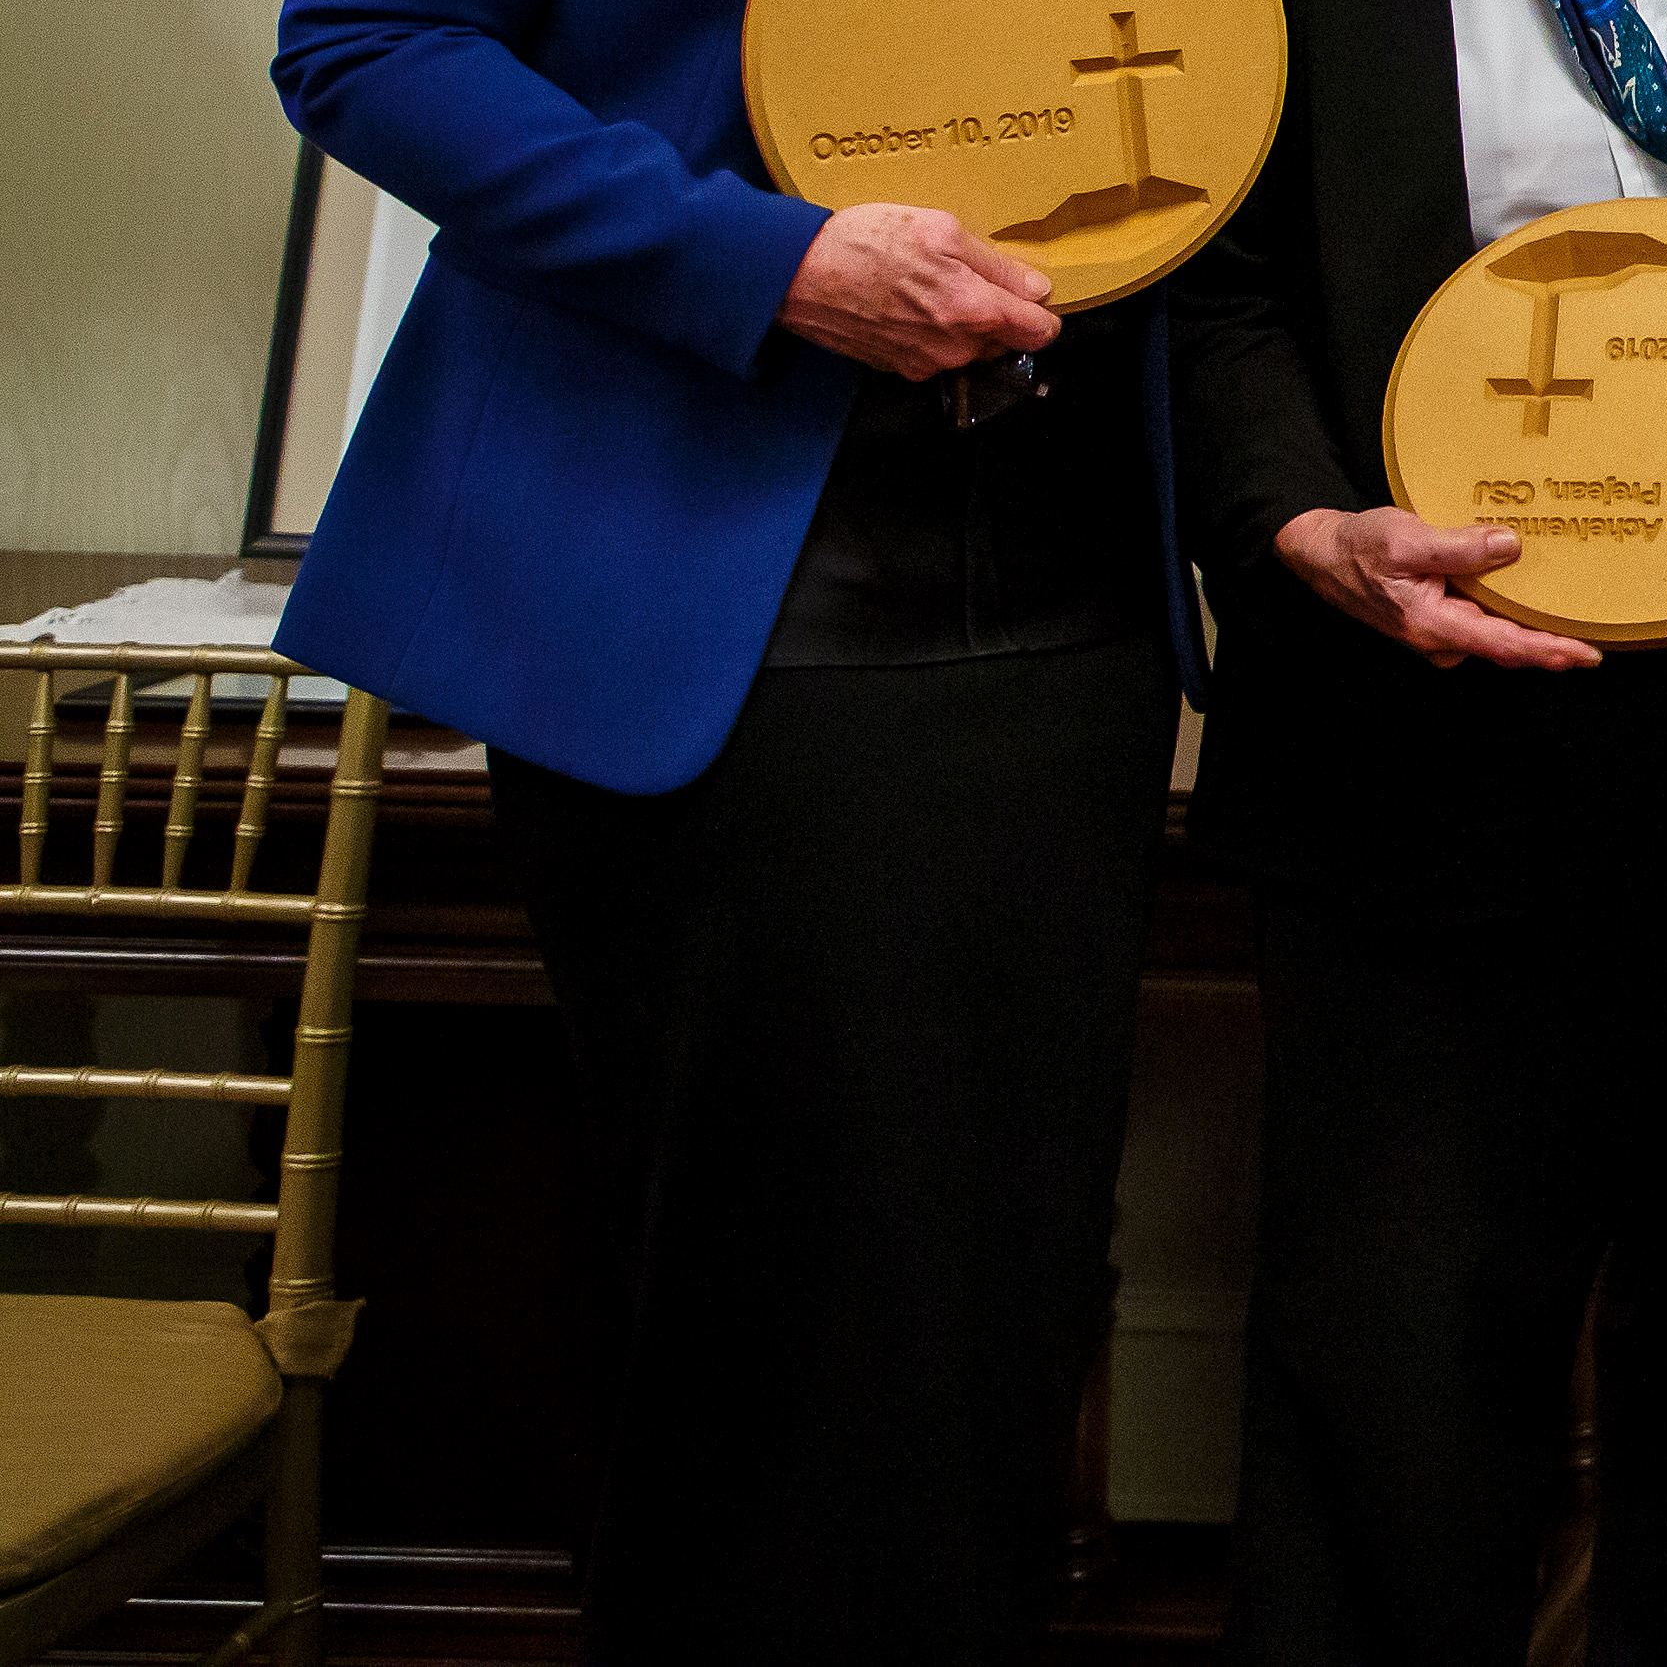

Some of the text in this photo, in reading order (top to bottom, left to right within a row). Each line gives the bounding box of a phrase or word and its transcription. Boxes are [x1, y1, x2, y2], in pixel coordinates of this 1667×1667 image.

[809, 106, 1076, 161] October 10, 2019
[1473, 479, 1536, 506] CSJ
[1544, 475, 1661, 506] Prejean,
